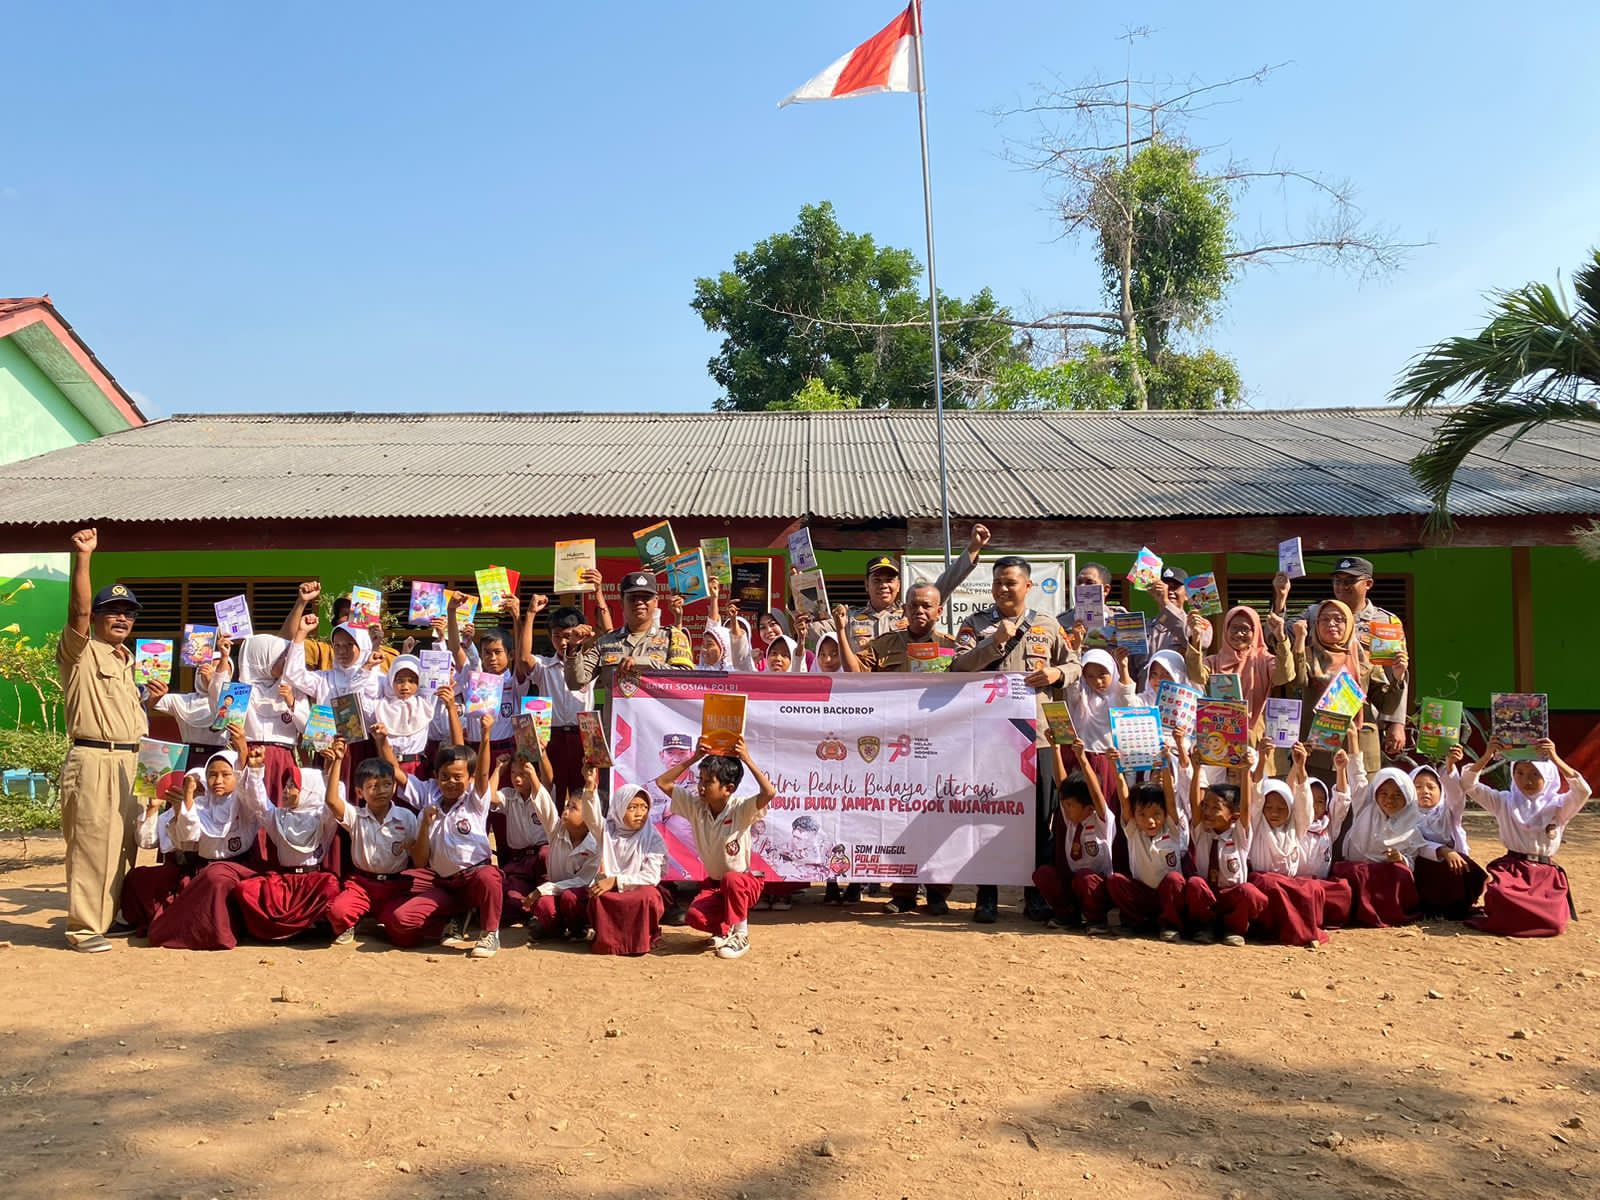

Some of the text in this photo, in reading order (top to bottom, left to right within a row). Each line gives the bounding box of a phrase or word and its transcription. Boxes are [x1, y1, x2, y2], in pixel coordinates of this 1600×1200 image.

[953, 602, 968, 612] SD
[1027, 635, 1049, 644] POLRI
[675, 682, 708, 691] SOSIAL
[711, 683, 739, 692] POLRI
[779, 705, 875, 715] CONTOH BACKDROP
[808, 771, 856, 796] Peduli
[864, 772, 927, 802] Budaya
[935, 773, 999, 800] Literasi
[804, 796, 838, 811] BUKU
[841, 796, 885, 811] SAMPAI
[888, 798, 945, 814] PELOSOK
[949, 799, 1025, 815] NUSANTARA
[854, 845, 907, 855] SDM UNGGUL
[854, 855, 881, 863] POLRI
